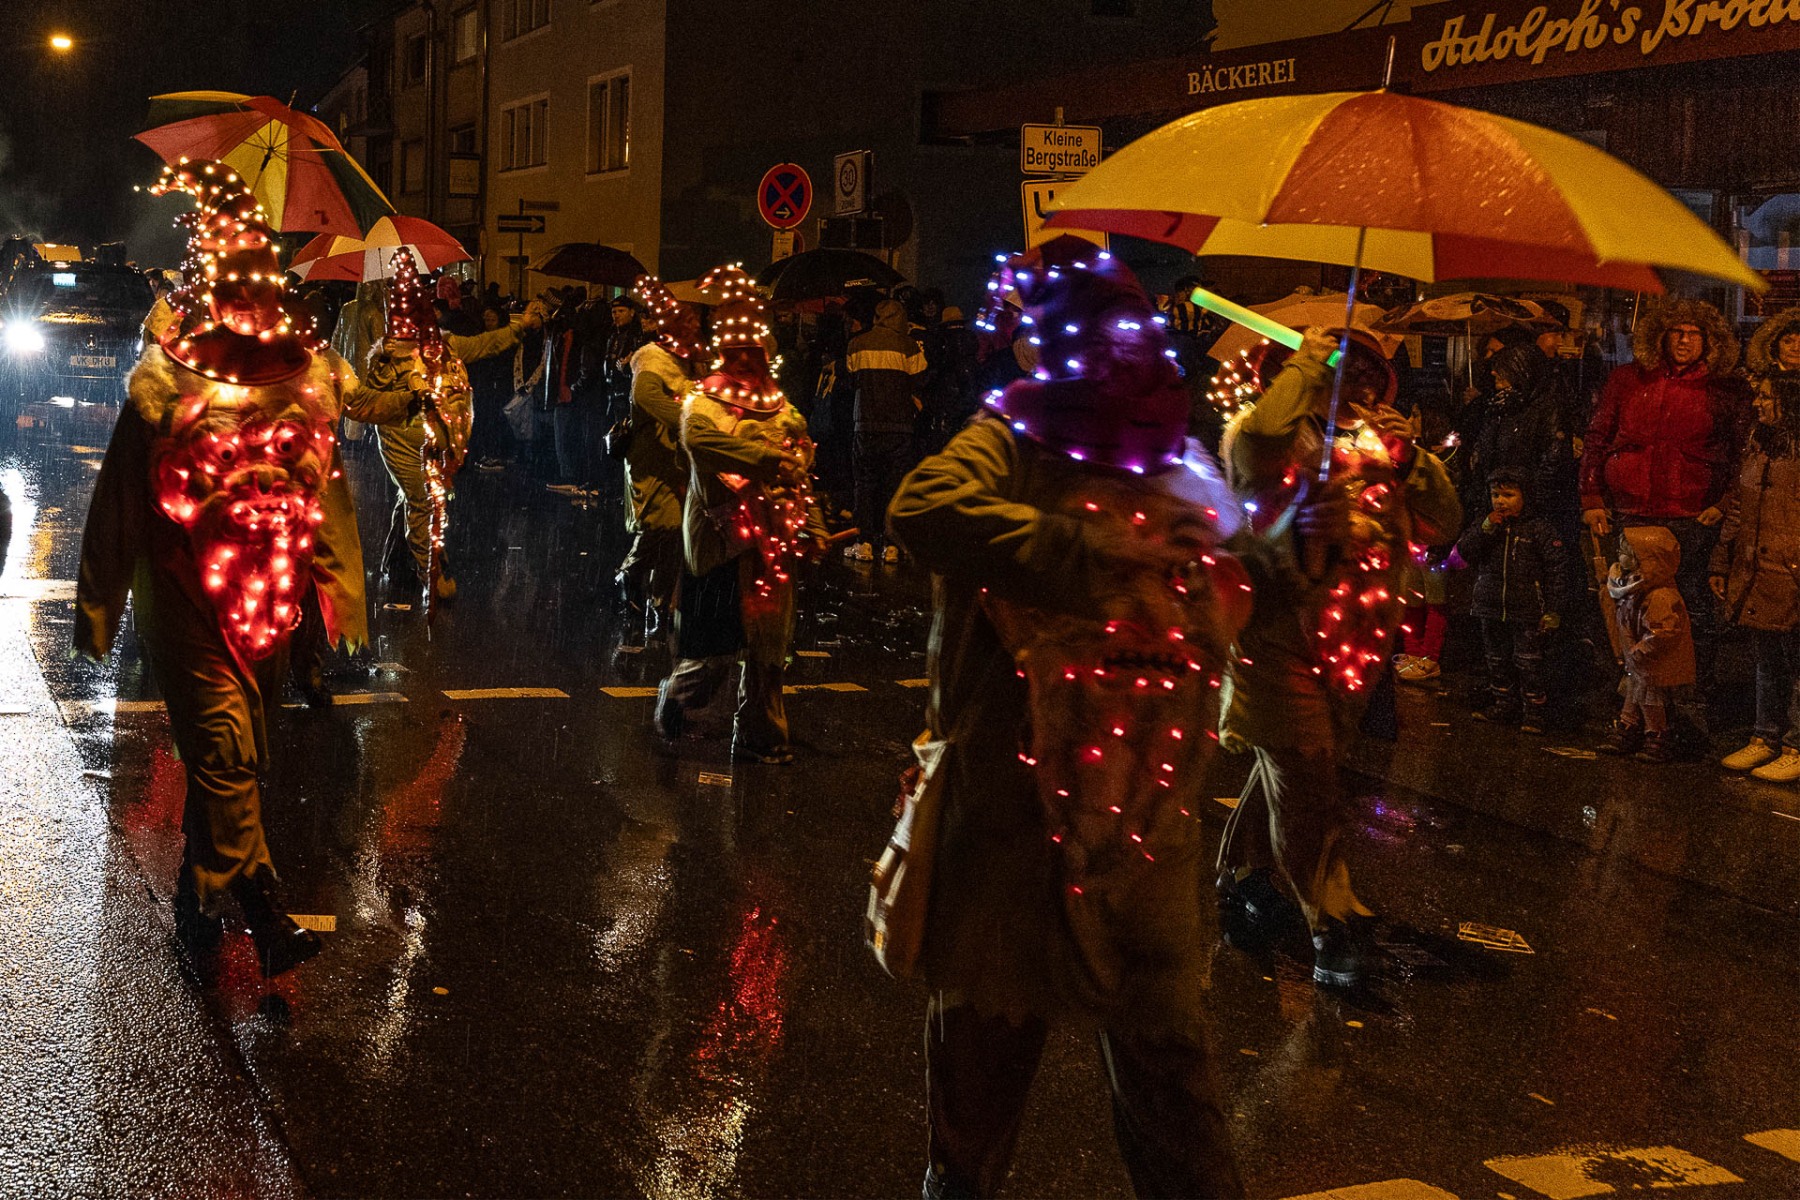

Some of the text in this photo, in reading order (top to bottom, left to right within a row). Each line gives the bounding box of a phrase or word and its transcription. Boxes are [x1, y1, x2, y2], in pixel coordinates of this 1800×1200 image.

[1421, 0, 1642, 72] Adolph's
[1187, 58, 1296, 95] BÄCKEREI
[1043, 130, 1083, 147] Kleine
[1026, 147, 1097, 170] Bergstraße
[842, 168, 854, 187] 30
